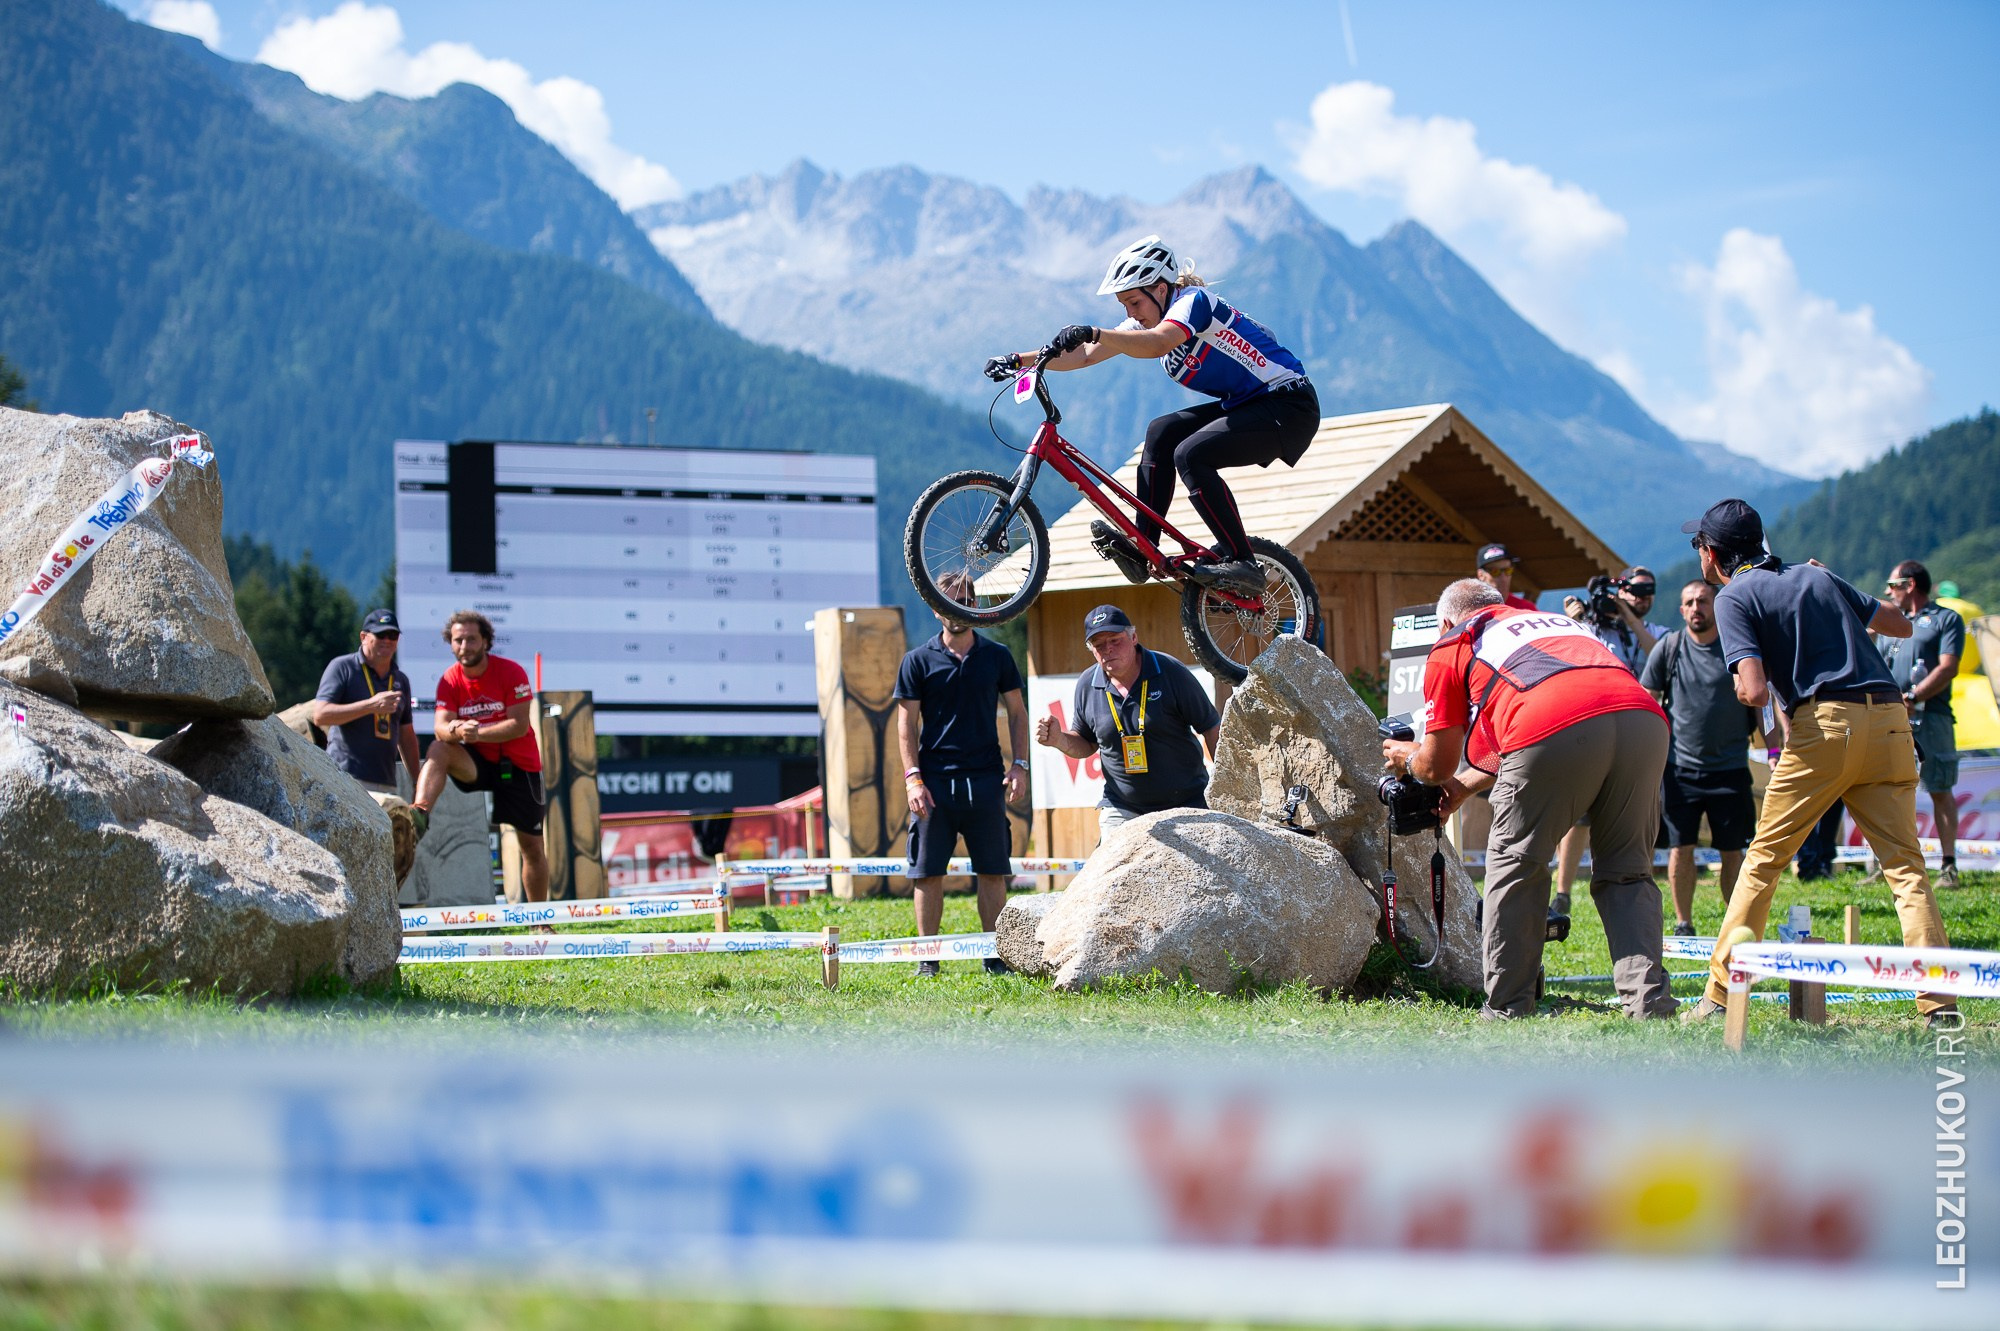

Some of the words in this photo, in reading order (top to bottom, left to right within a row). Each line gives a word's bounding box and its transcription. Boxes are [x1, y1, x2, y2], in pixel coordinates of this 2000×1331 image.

[1215, 329, 1267, 368] STRABAG
[1215, 340, 1237, 357] TEAMS
[1236, 353, 1255, 372] WORK.
[88, 481, 145, 531] TRENTINO
[52, 534, 95, 569] Sole
[24, 572, 55, 596] Val
[51, 564, 65, 578] di
[1397, 618, 1413, 630] UCI
[1507, 617, 1592, 637] PHOT
[1393, 664, 1427, 694] STA
[597, 771, 660, 794] ATCH
[665, 771, 691, 793] IT
[693, 770, 732, 793] ON
[857, 863, 902, 874] TRENTINO
[1434, 874, 1442, 902] Canon
[402, 915, 428, 930] TINO
[441, 911, 459, 925] Val
[468, 910, 496, 923] Sole
[502, 907, 555, 924] TRENTINO
[567, 905, 585, 918] Val
[594, 904, 621, 916] Sole
[628, 901, 679, 916] TRENTINO
[1864, 956, 1895, 980] Val
[1899, 968, 1913, 982] di
[1912, 959, 1960, 984] Sole
